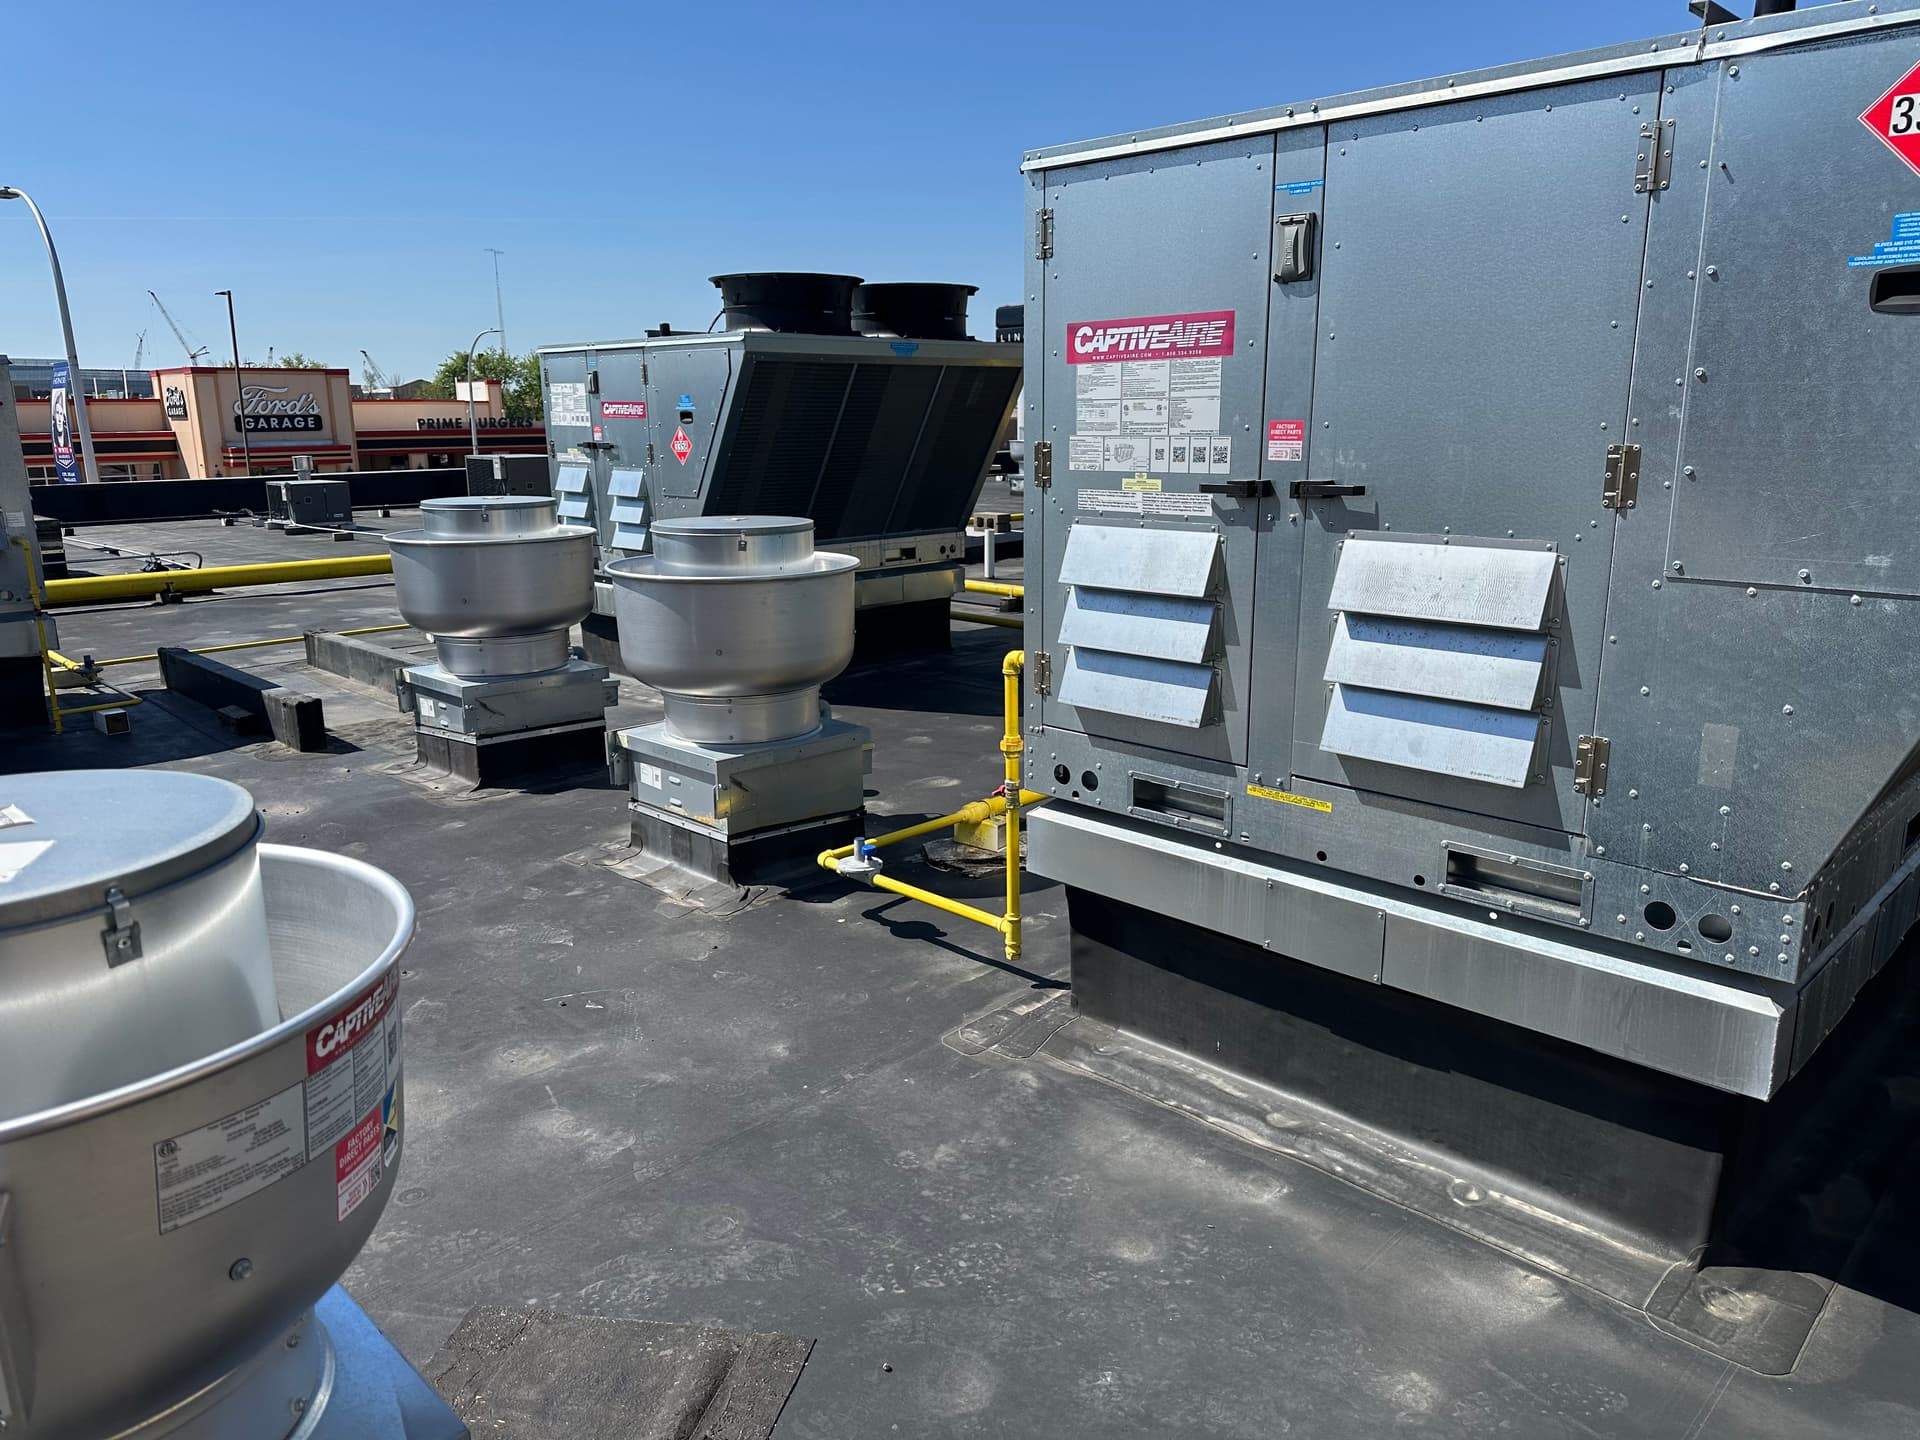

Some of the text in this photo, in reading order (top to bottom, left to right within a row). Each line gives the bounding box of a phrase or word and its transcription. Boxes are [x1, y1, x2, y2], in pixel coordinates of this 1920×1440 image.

[1892, 96, 1920, 134] 3
[1000, 332, 1024, 343] LIN
[233, 384, 320, 415] Ford's
[244, 416, 316, 430] GARAGE
[417, 418, 463, 430] PRIME
